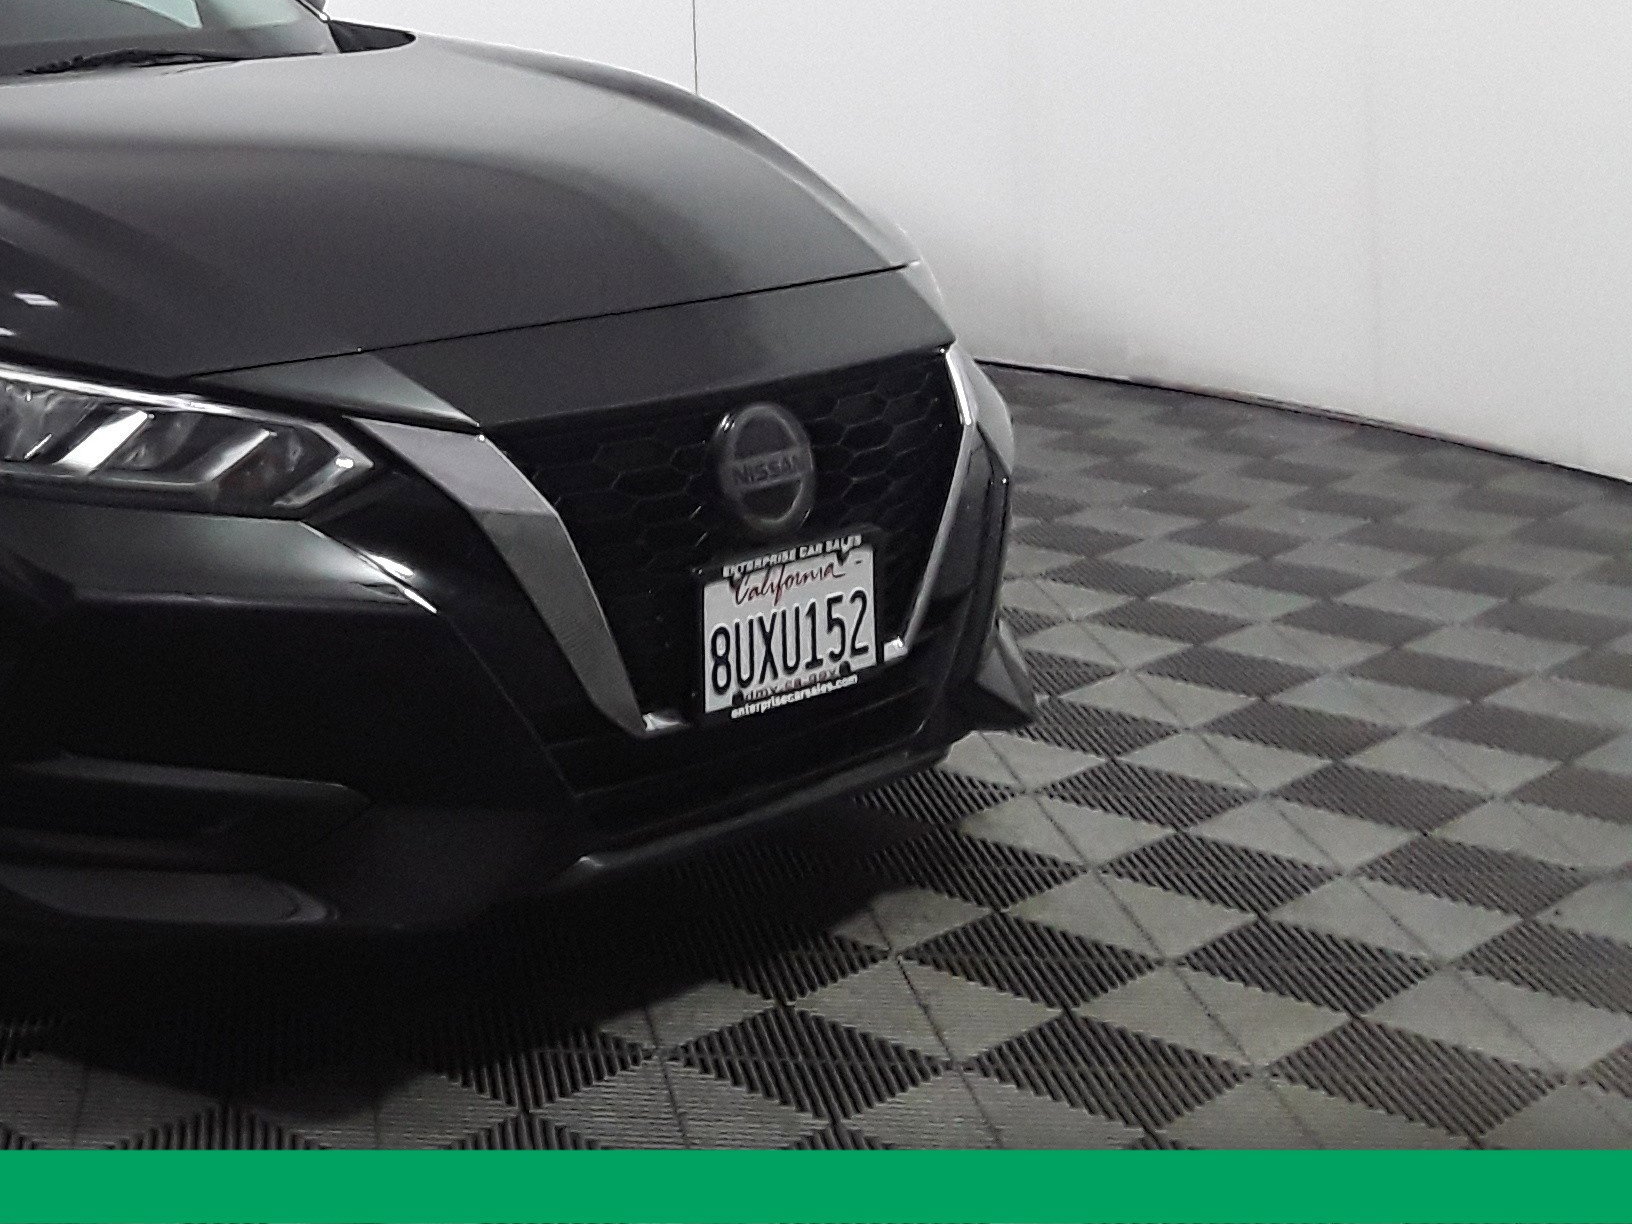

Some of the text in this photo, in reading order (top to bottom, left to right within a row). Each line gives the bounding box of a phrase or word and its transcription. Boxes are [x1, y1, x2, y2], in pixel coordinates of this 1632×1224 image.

[734, 454, 798, 484] NISSAN
[723, 534, 862, 578] ENTERPRISE CAR SALES
[734, 562, 845, 606] California
[710, 590, 870, 694] 8UXU152
[731, 674, 859, 719] enterprisecarsales.com
